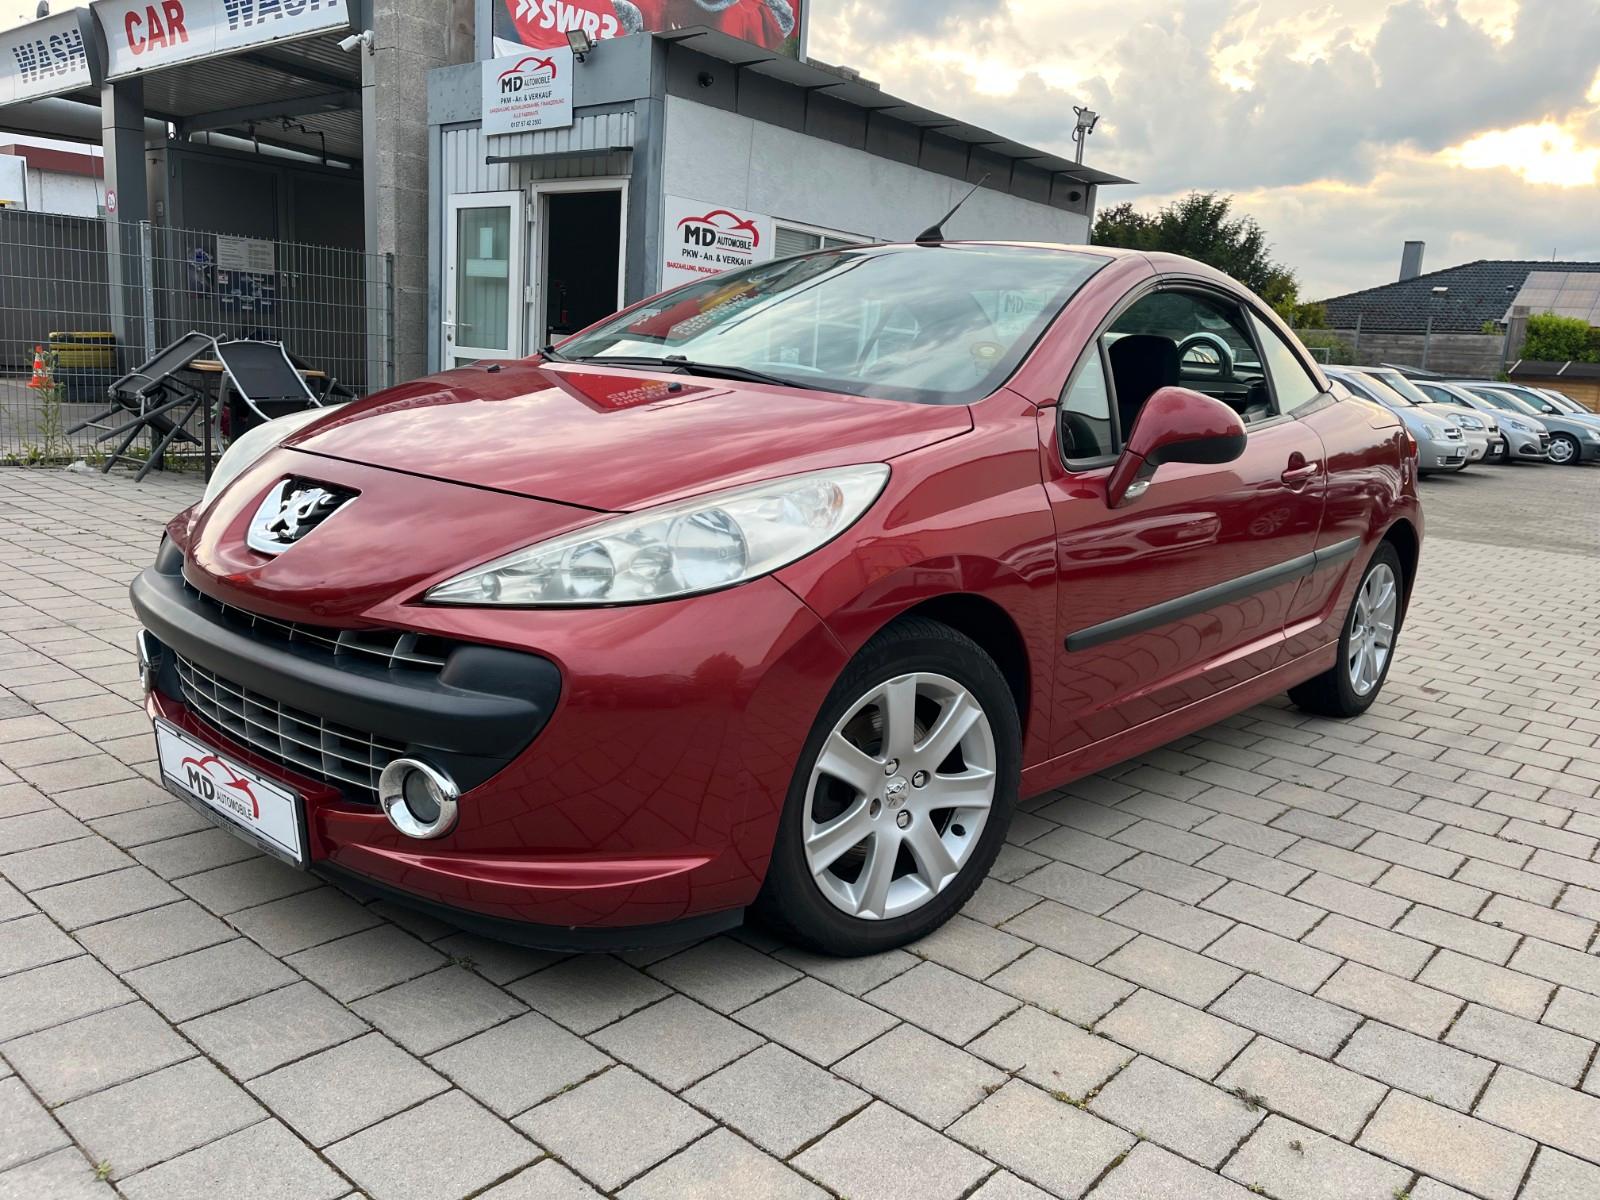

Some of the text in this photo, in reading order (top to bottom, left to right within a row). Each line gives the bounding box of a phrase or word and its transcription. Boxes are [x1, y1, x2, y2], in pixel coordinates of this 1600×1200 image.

[124, 0, 189, 56] CAR
[540, 0, 618, 39] SWR3
[12, 28, 86, 84] WASH
[501, 75, 551, 93] MD AUTOMOBILE
[528, 90, 552, 100] VERKAUF
[684, 224, 752, 250] MD AUTOMOBILE
[682, 248, 699, 258] PKW
[703, 252, 715, 261] An.
[715, 254, 721, 263] &
[187, 765, 215, 801] MD
[216, 792, 253, 821] AUTOMOBILE
